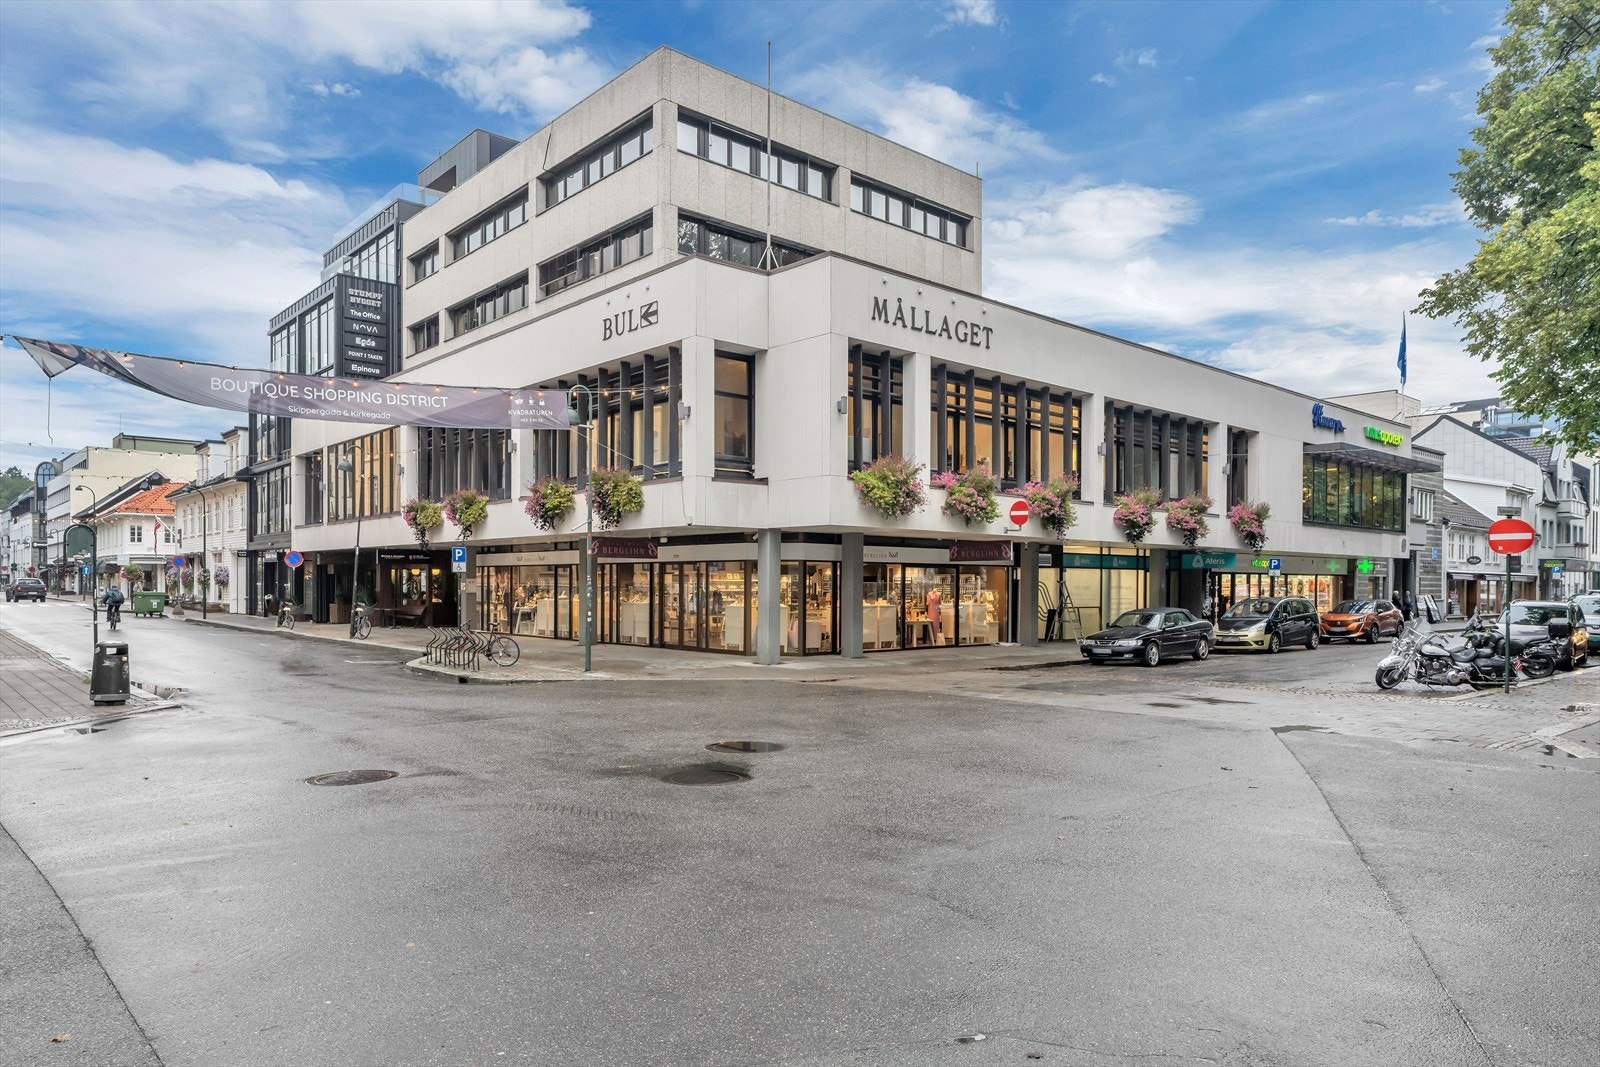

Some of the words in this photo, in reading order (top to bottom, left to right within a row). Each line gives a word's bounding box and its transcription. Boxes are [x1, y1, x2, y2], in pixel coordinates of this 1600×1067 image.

[348, 288, 383, 300] STUMPF
[350, 296, 382, 307] BYGGET
[350, 309, 361, 317] The
[362, 311, 381, 320] Office
[870, 295, 994, 350] MÅLLAGET
[348, 350, 363, 358] POINT
[367, 353, 383, 361] TAKEN
[351, 364, 380, 374] Epinova
[210, 377, 300, 400] BOUTIQUE
[303, 386, 382, 405] SHOPPING
[387, 393, 449, 408] DISTRICT
[288, 405, 341, 417] Skippergada
[342, 409, 349, 417] &
[350, 410, 391, 420] Kirkegada
[455, 549, 463, 560] P
[1205, 557, 1226, 565] Aleris
[1271, 559, 1279, 569] P
